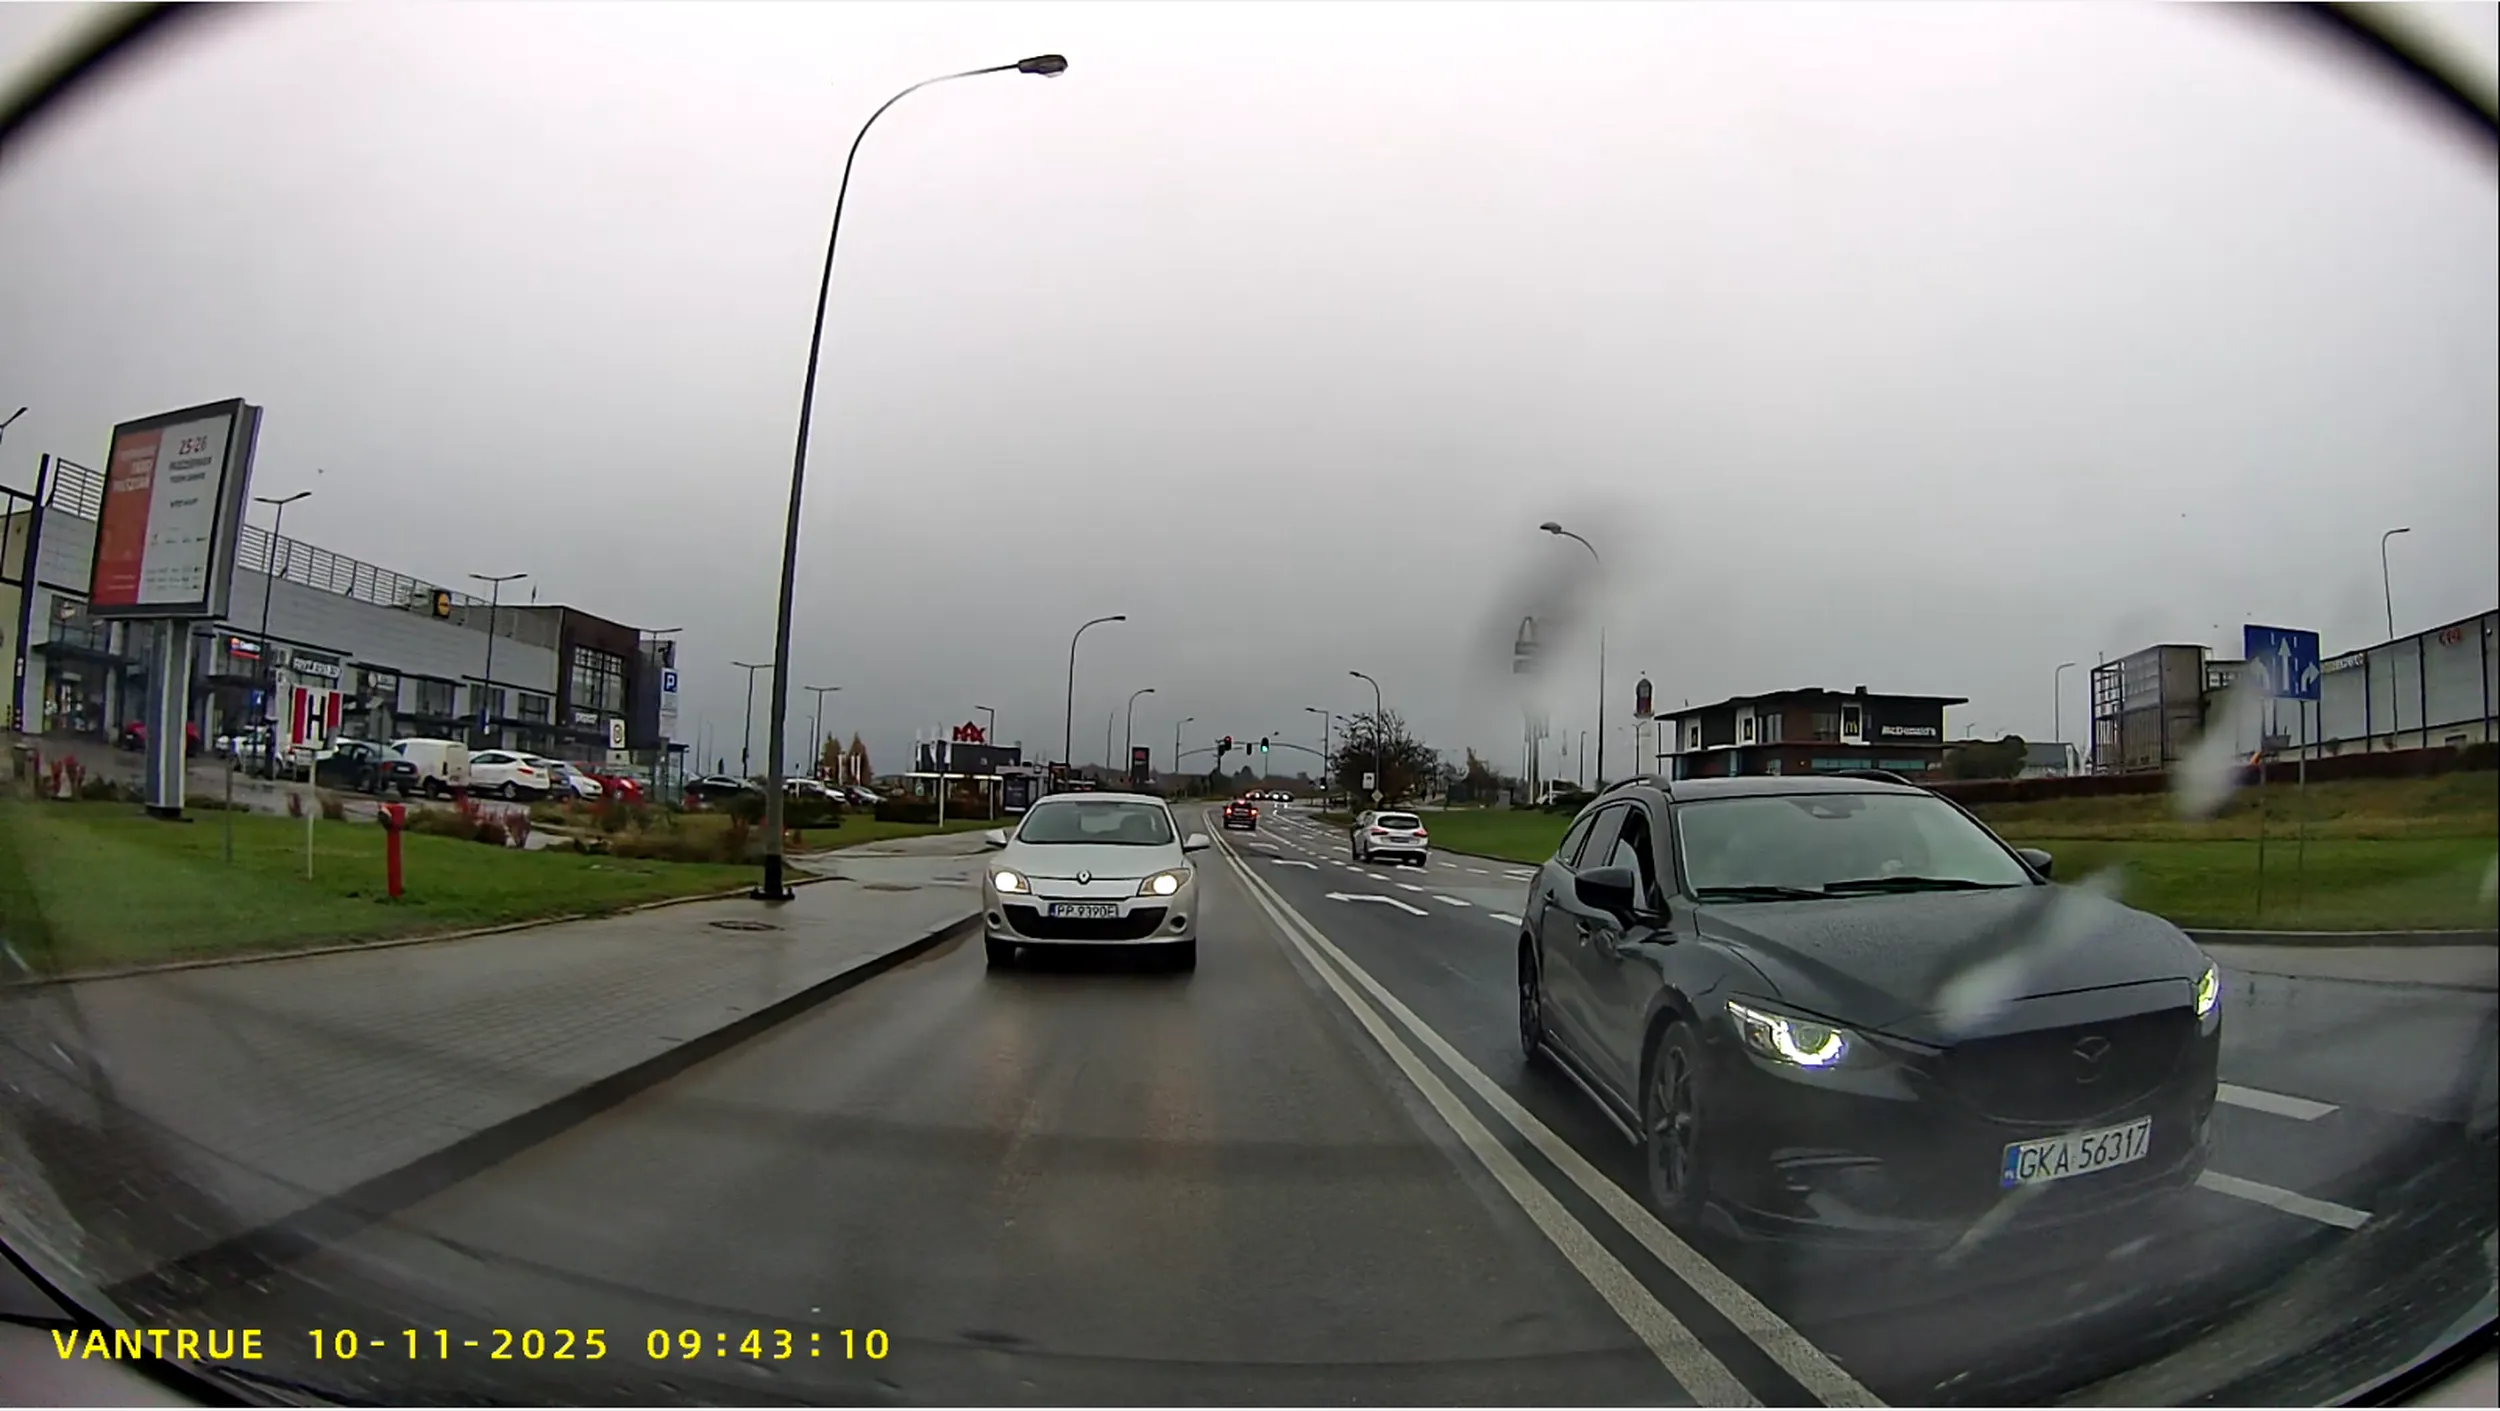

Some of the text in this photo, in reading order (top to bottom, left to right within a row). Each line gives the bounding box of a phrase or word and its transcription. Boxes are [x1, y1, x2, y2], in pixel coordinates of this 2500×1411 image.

[306, 694, 327, 741] H
[953, 721, 986, 743] MAX
[2019, 1123, 2149, 1180] GKA 56317
